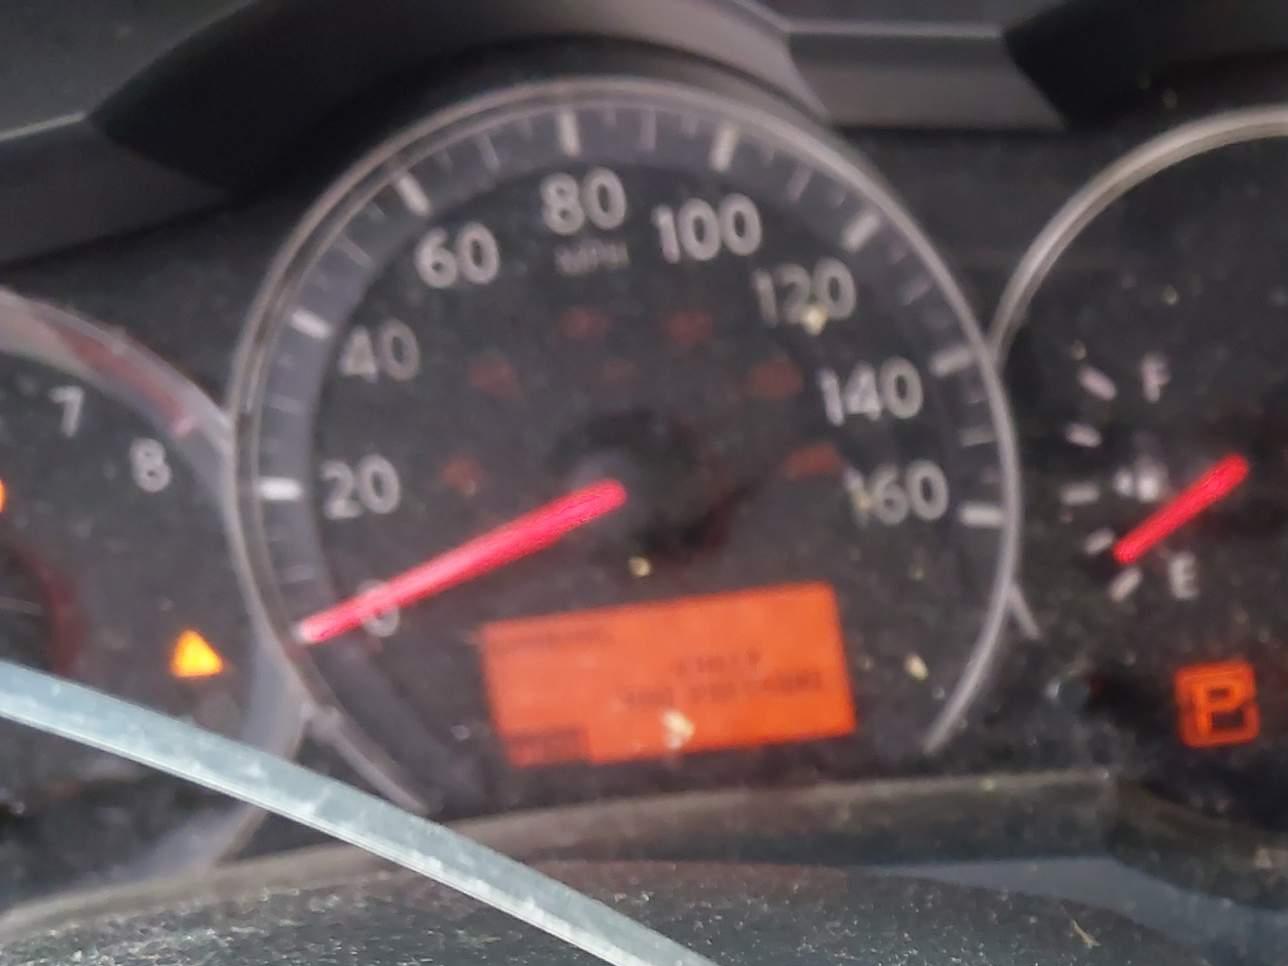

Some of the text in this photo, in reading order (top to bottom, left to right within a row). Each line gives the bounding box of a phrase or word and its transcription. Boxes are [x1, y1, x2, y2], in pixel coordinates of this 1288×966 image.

[541, 166, 627, 236] 80
[651, 193, 761, 264] 100
[415, 223, 500, 288] 60
[752, 258, 857, 326] 120
[340, 319, 420, 382] 40
[1141, 352, 1169, 402] F
[49, 385, 85, 438] 7
[818, 358, 923, 426] 140
[130, 438, 173, 492] 8
[320, 454, 400, 520] 20
[845, 460, 949, 526] 160
[1169, 554, 1197, 599] E
[1189, 672, 1247, 742] P
